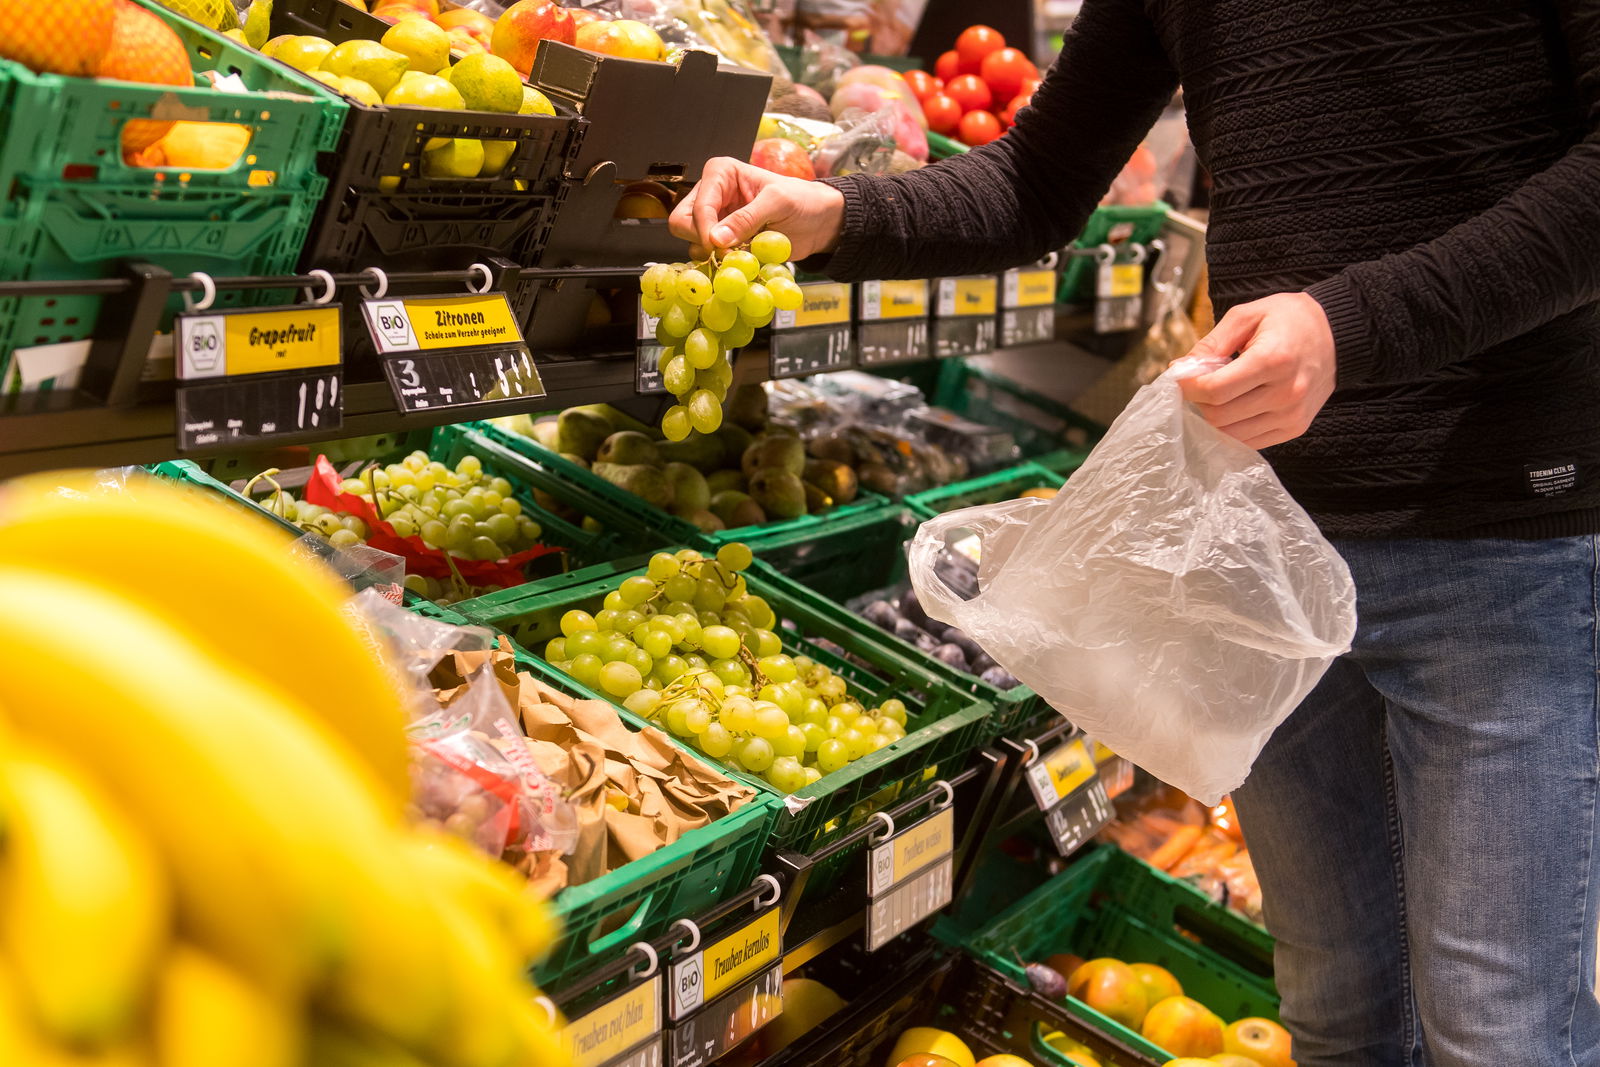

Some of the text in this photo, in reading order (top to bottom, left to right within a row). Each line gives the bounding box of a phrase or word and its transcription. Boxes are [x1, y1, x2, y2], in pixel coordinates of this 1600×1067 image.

[424, 325, 506, 341] Schale zum Verzehr geeignet
[434, 310, 485, 328] Zitronen
[248, 322, 316, 350] Grapefruit
[397, 359, 420, 387] 3
[714, 930, 770, 981] Trauben kernlos
